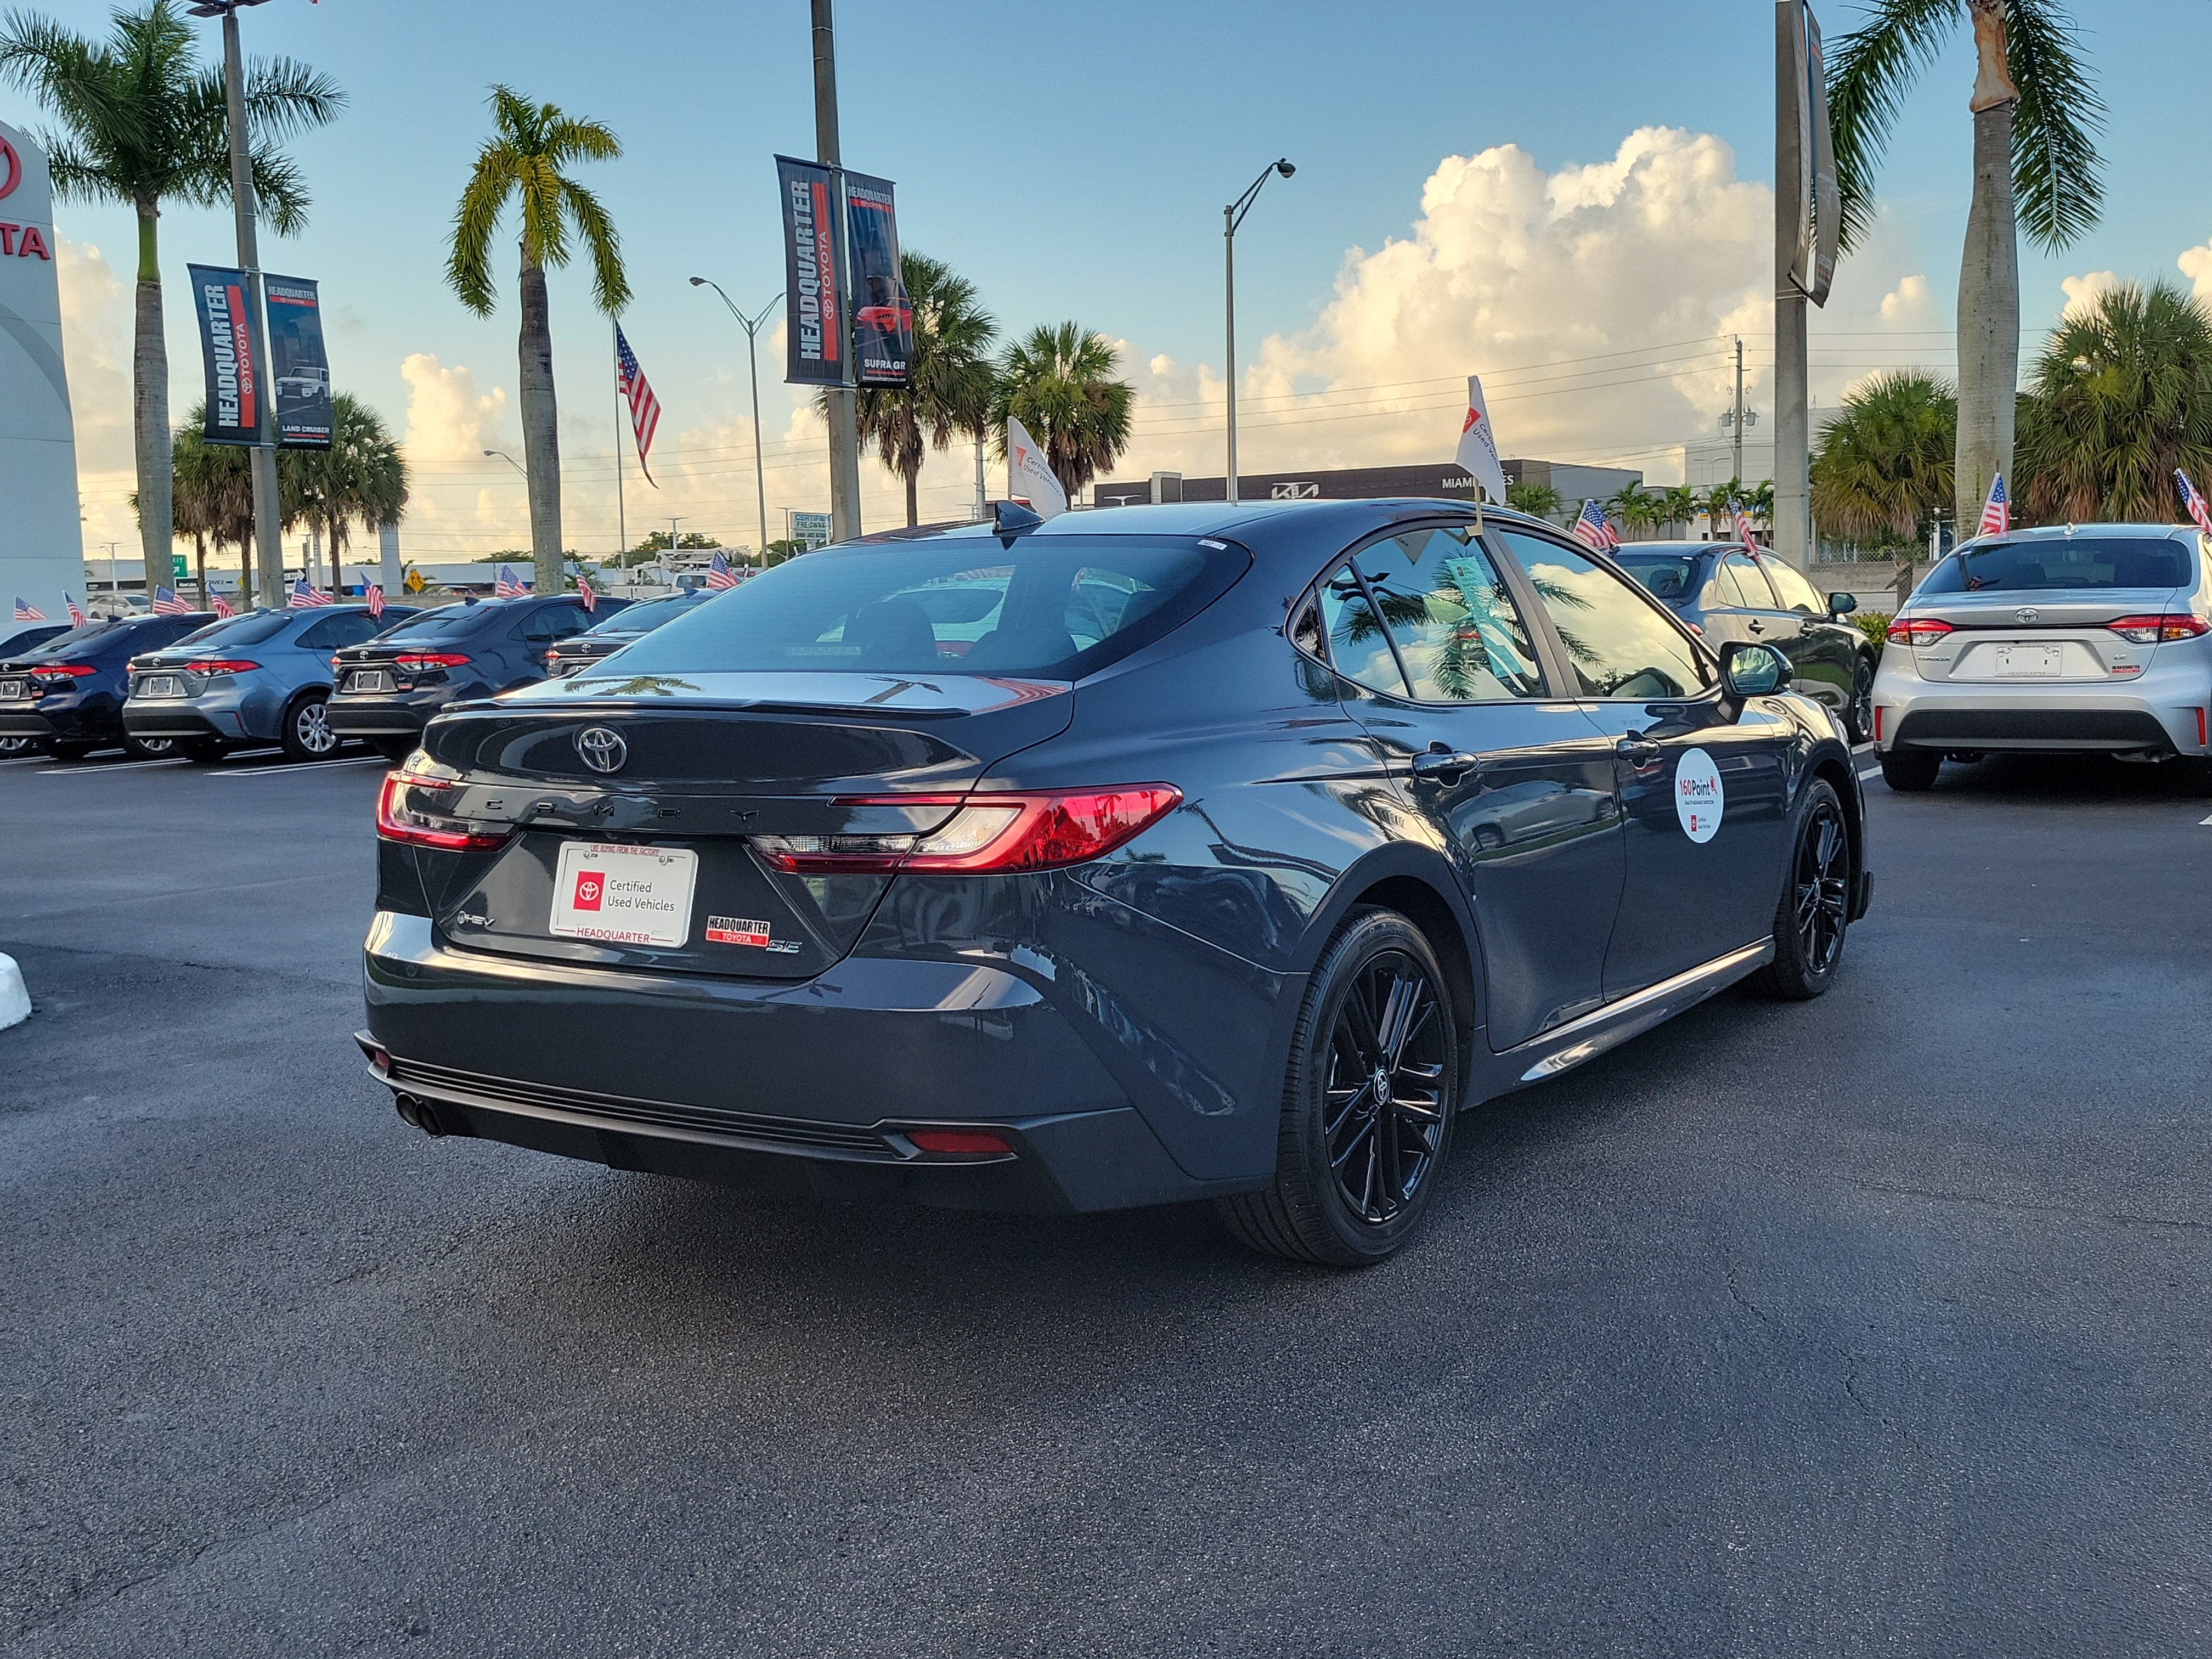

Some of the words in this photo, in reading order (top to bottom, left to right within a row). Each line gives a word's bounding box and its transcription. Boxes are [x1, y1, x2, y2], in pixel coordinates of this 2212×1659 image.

[849, 186, 892, 205] HEADQUARTER
[792, 180, 821, 360] HEADQUARTER
[819, 232, 834, 297] TOYOTA
[268, 286, 315, 300] HEADQUARTER
[205, 285, 238, 427] HEADQUARTER
[236, 323, 250, 375] TOYOTA
[864, 358, 892, 369] SUPRA
[893, 360, 906, 370] GR
[1473, 428, 1489, 447] Used
[1023, 464, 1040, 476] Used
[485, 799, 761, 822] CAMRY
[610, 879, 652, 893] Certified
[607, 895, 632, 909] Used
[635, 898, 675, 911] Vehicles
[709, 917, 769, 935] HEADQUARTER
[576, 927, 650, 943] HEADQUARTER
[722, 932, 752, 943] TOYOTA
[766, 940, 803, 953] SE
